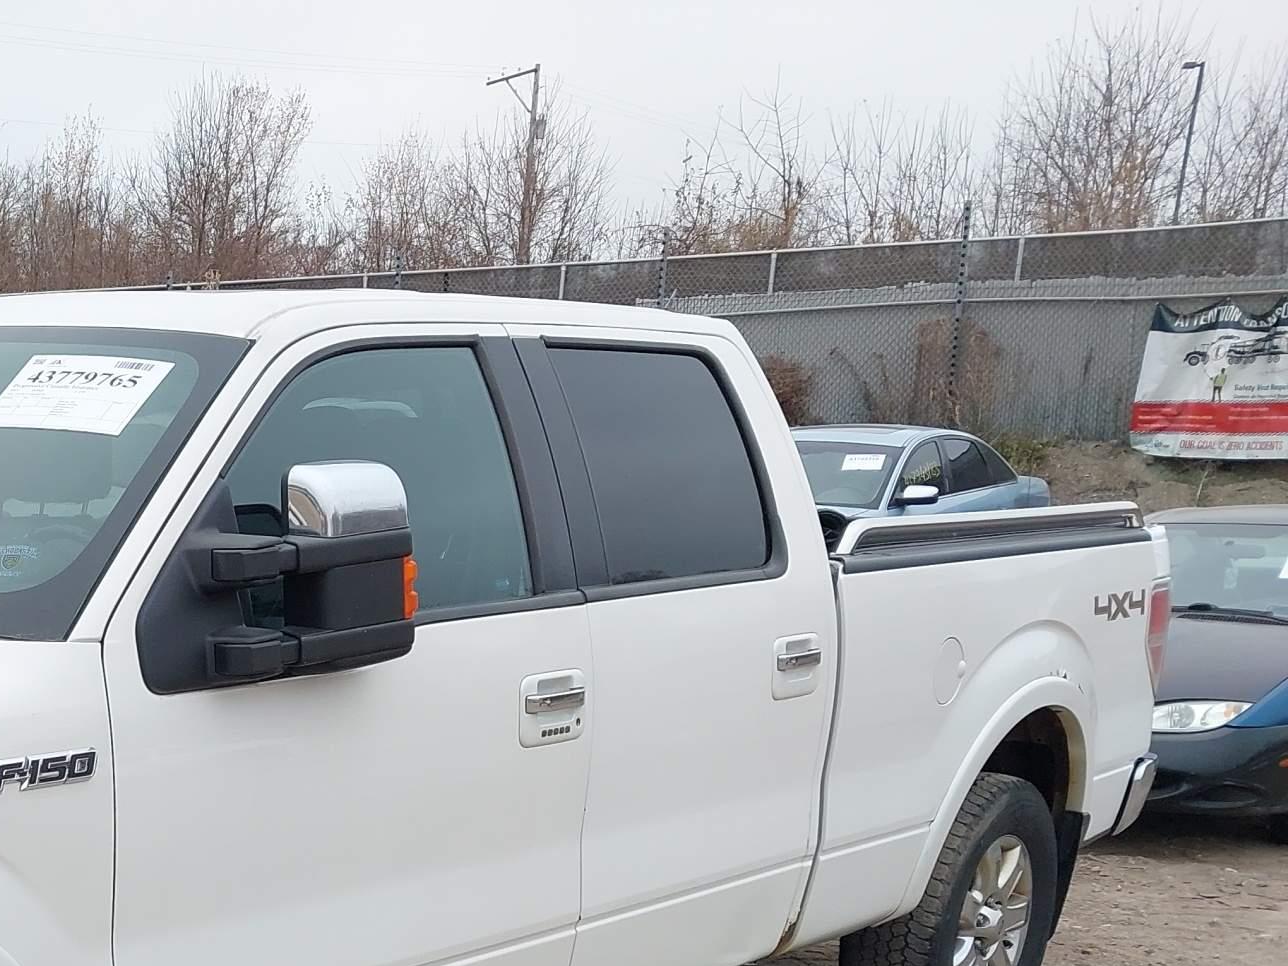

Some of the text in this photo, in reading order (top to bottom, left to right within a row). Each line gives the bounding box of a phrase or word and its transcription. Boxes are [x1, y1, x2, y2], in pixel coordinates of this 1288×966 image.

[1174, 305, 1243, 328] ATTENTION
[27, 370, 143, 389] 43779765
[1179, 440, 1195, 449] OUR
[1197, 440, 1216, 450] GOAL
[1225, 441, 1245, 451] ZERO
[1246, 440, 1284, 451] ACCIDENTS
